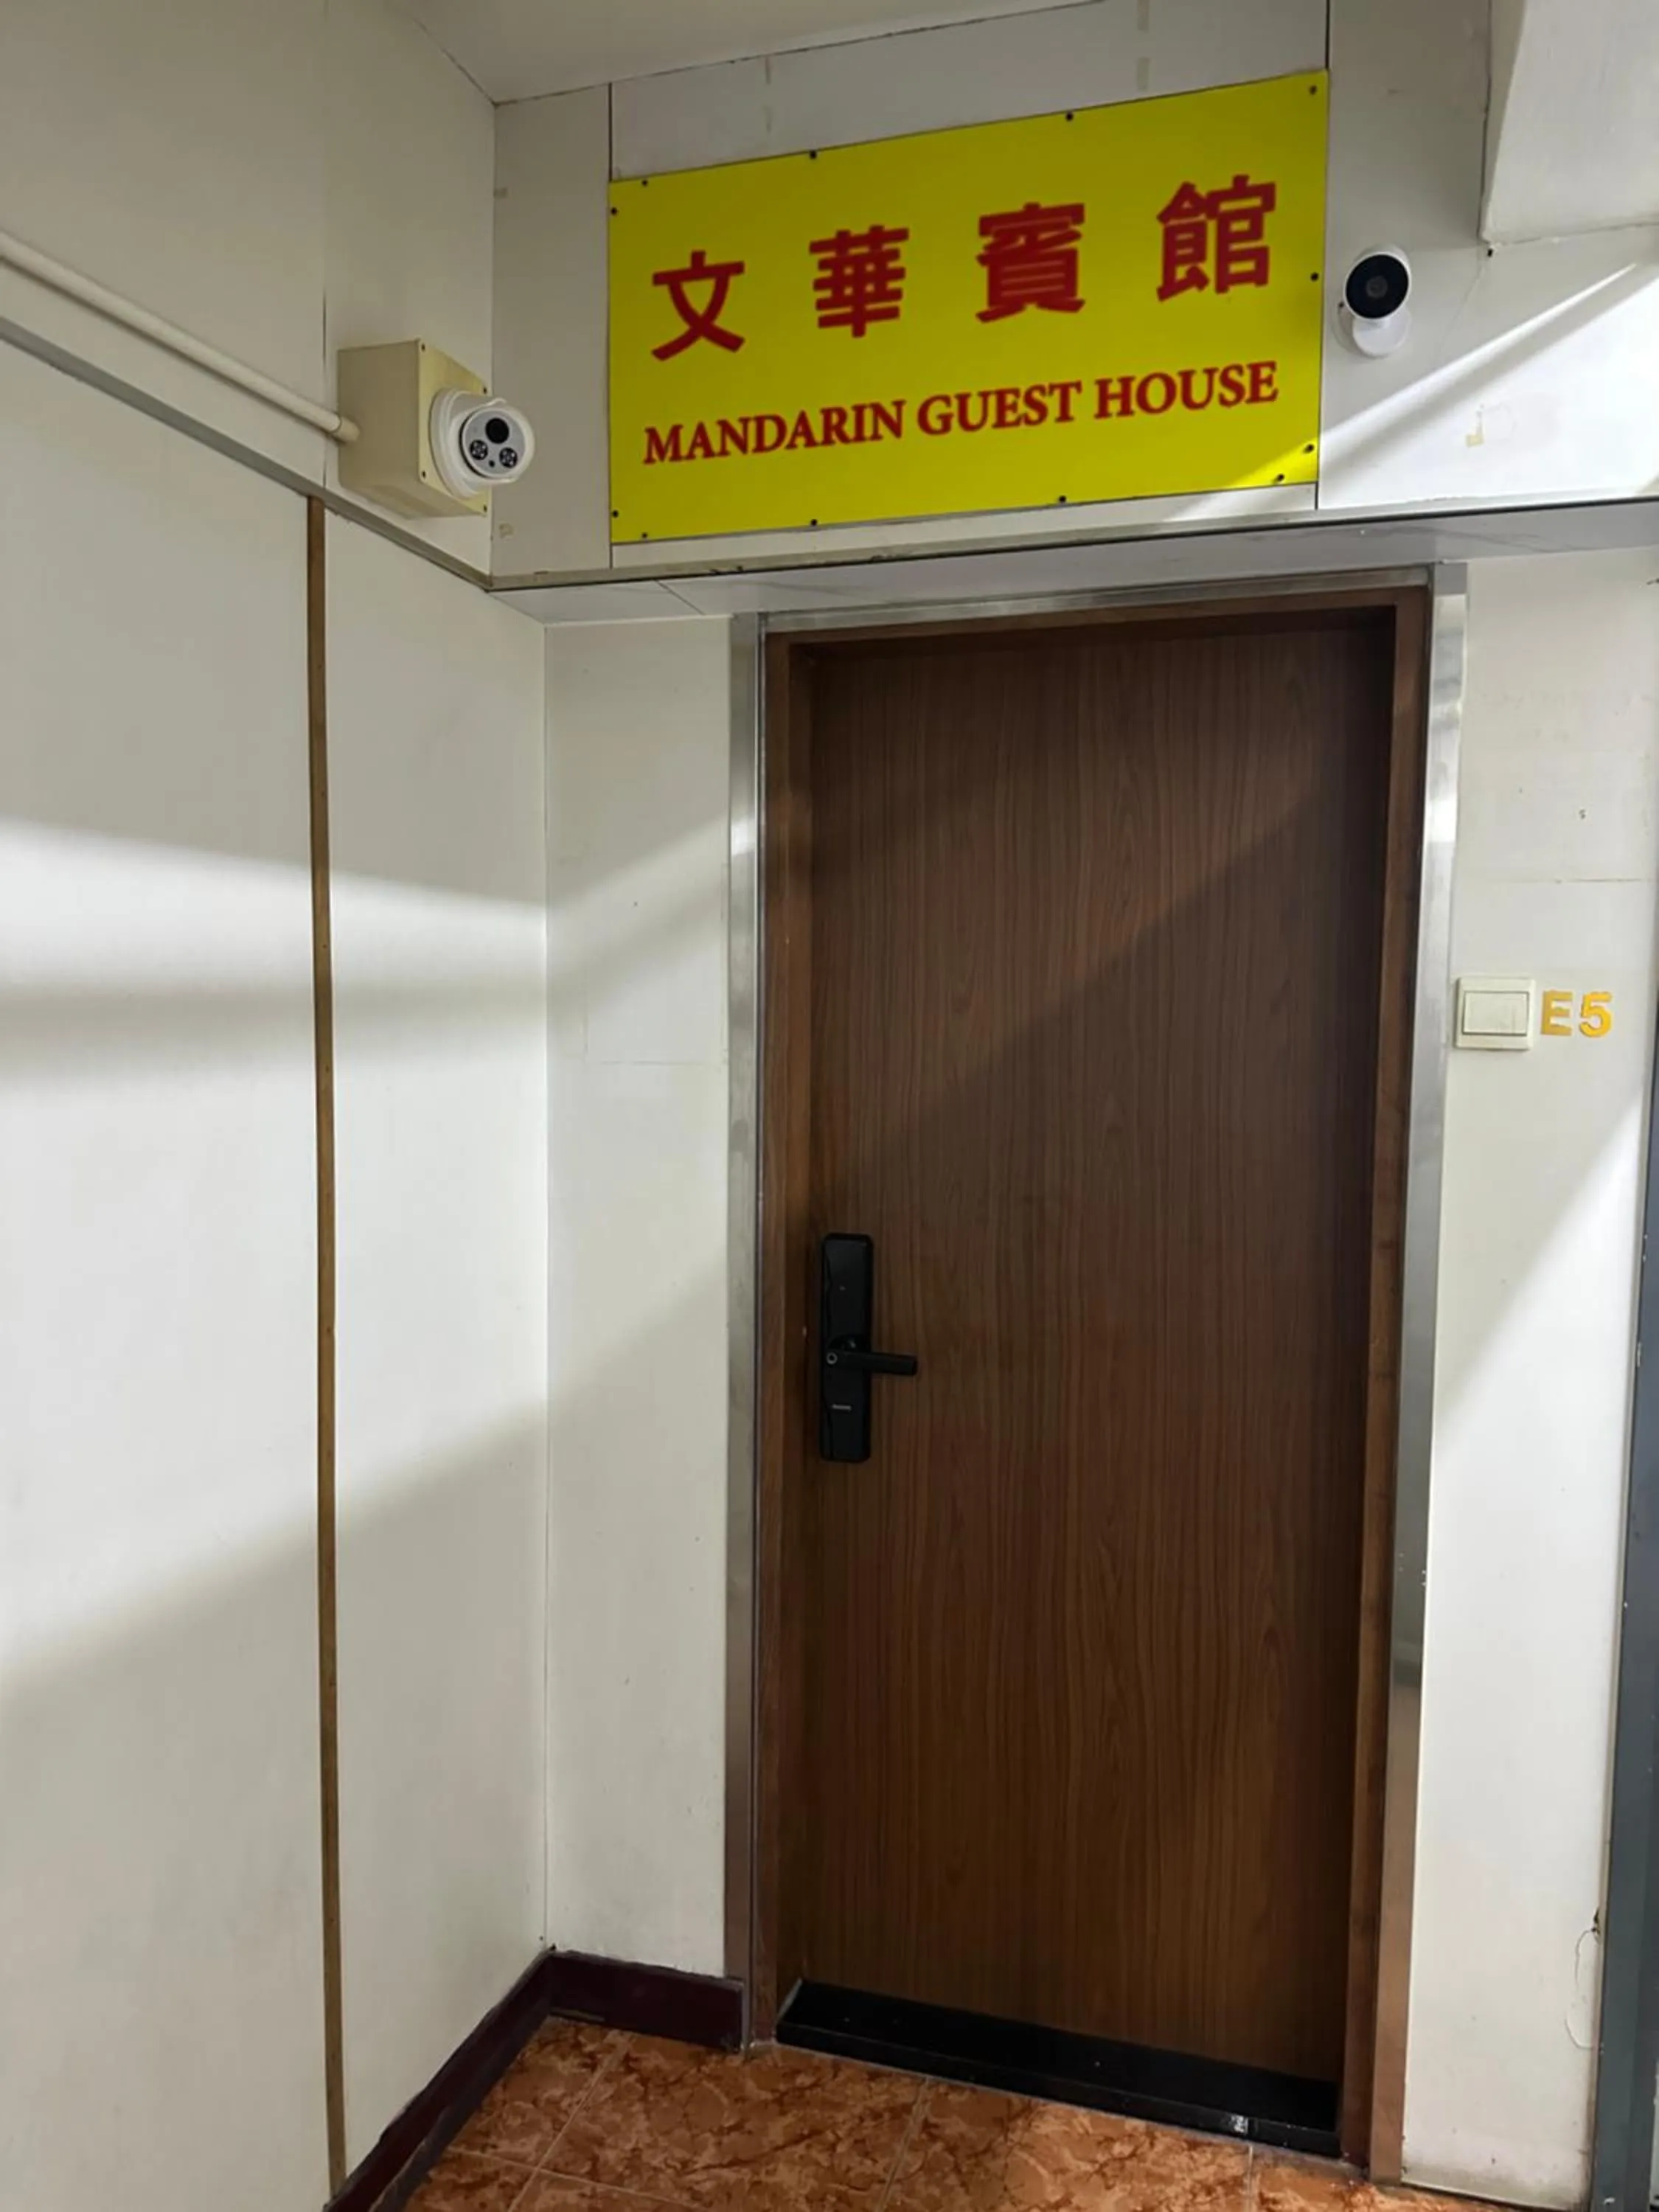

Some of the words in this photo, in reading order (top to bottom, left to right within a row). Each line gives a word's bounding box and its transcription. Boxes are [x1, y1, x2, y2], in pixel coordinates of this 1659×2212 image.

[650, 174, 1278, 362] 文華賓館
[643, 400, 907, 465] MANDARIN
[917, 380, 1082, 436] GUEST
[1094, 361, 1279, 419] HOUSE
[1540, 990, 1613, 1038] E5
